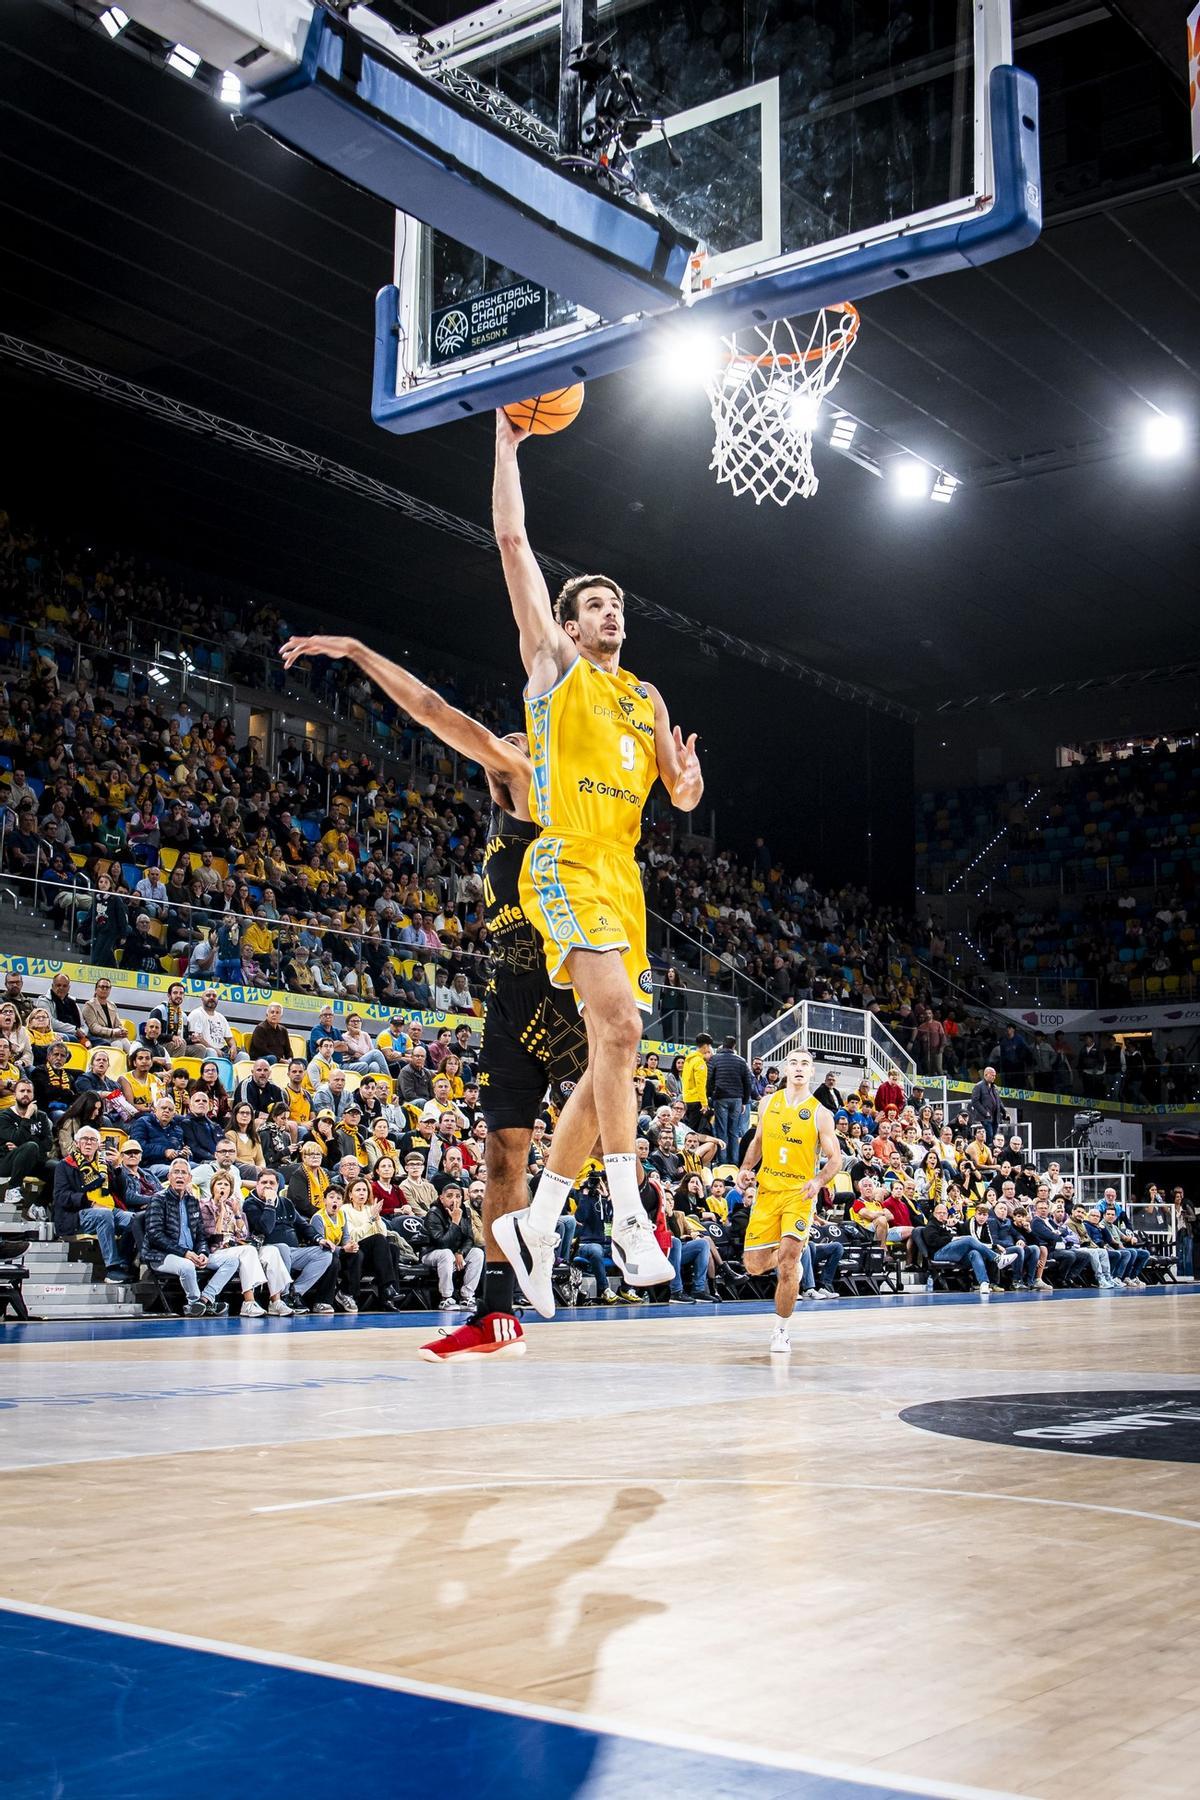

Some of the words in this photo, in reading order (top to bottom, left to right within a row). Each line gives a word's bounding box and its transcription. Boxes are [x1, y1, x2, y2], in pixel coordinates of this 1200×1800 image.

[471, 284, 533, 312] BASKETBALL
[471, 291, 541, 324] CHAMPIONS
[471, 313, 509, 335] LEAGUE
[471, 329, 501, 347] SEASON
[501, 327, 508, 336] X
[619, 734, 636, 772] 9
[596, 782, 640, 808] GranCan
[1040, 1013, 1064, 1026] trop
[779, 1147, 788, 1165] 5
